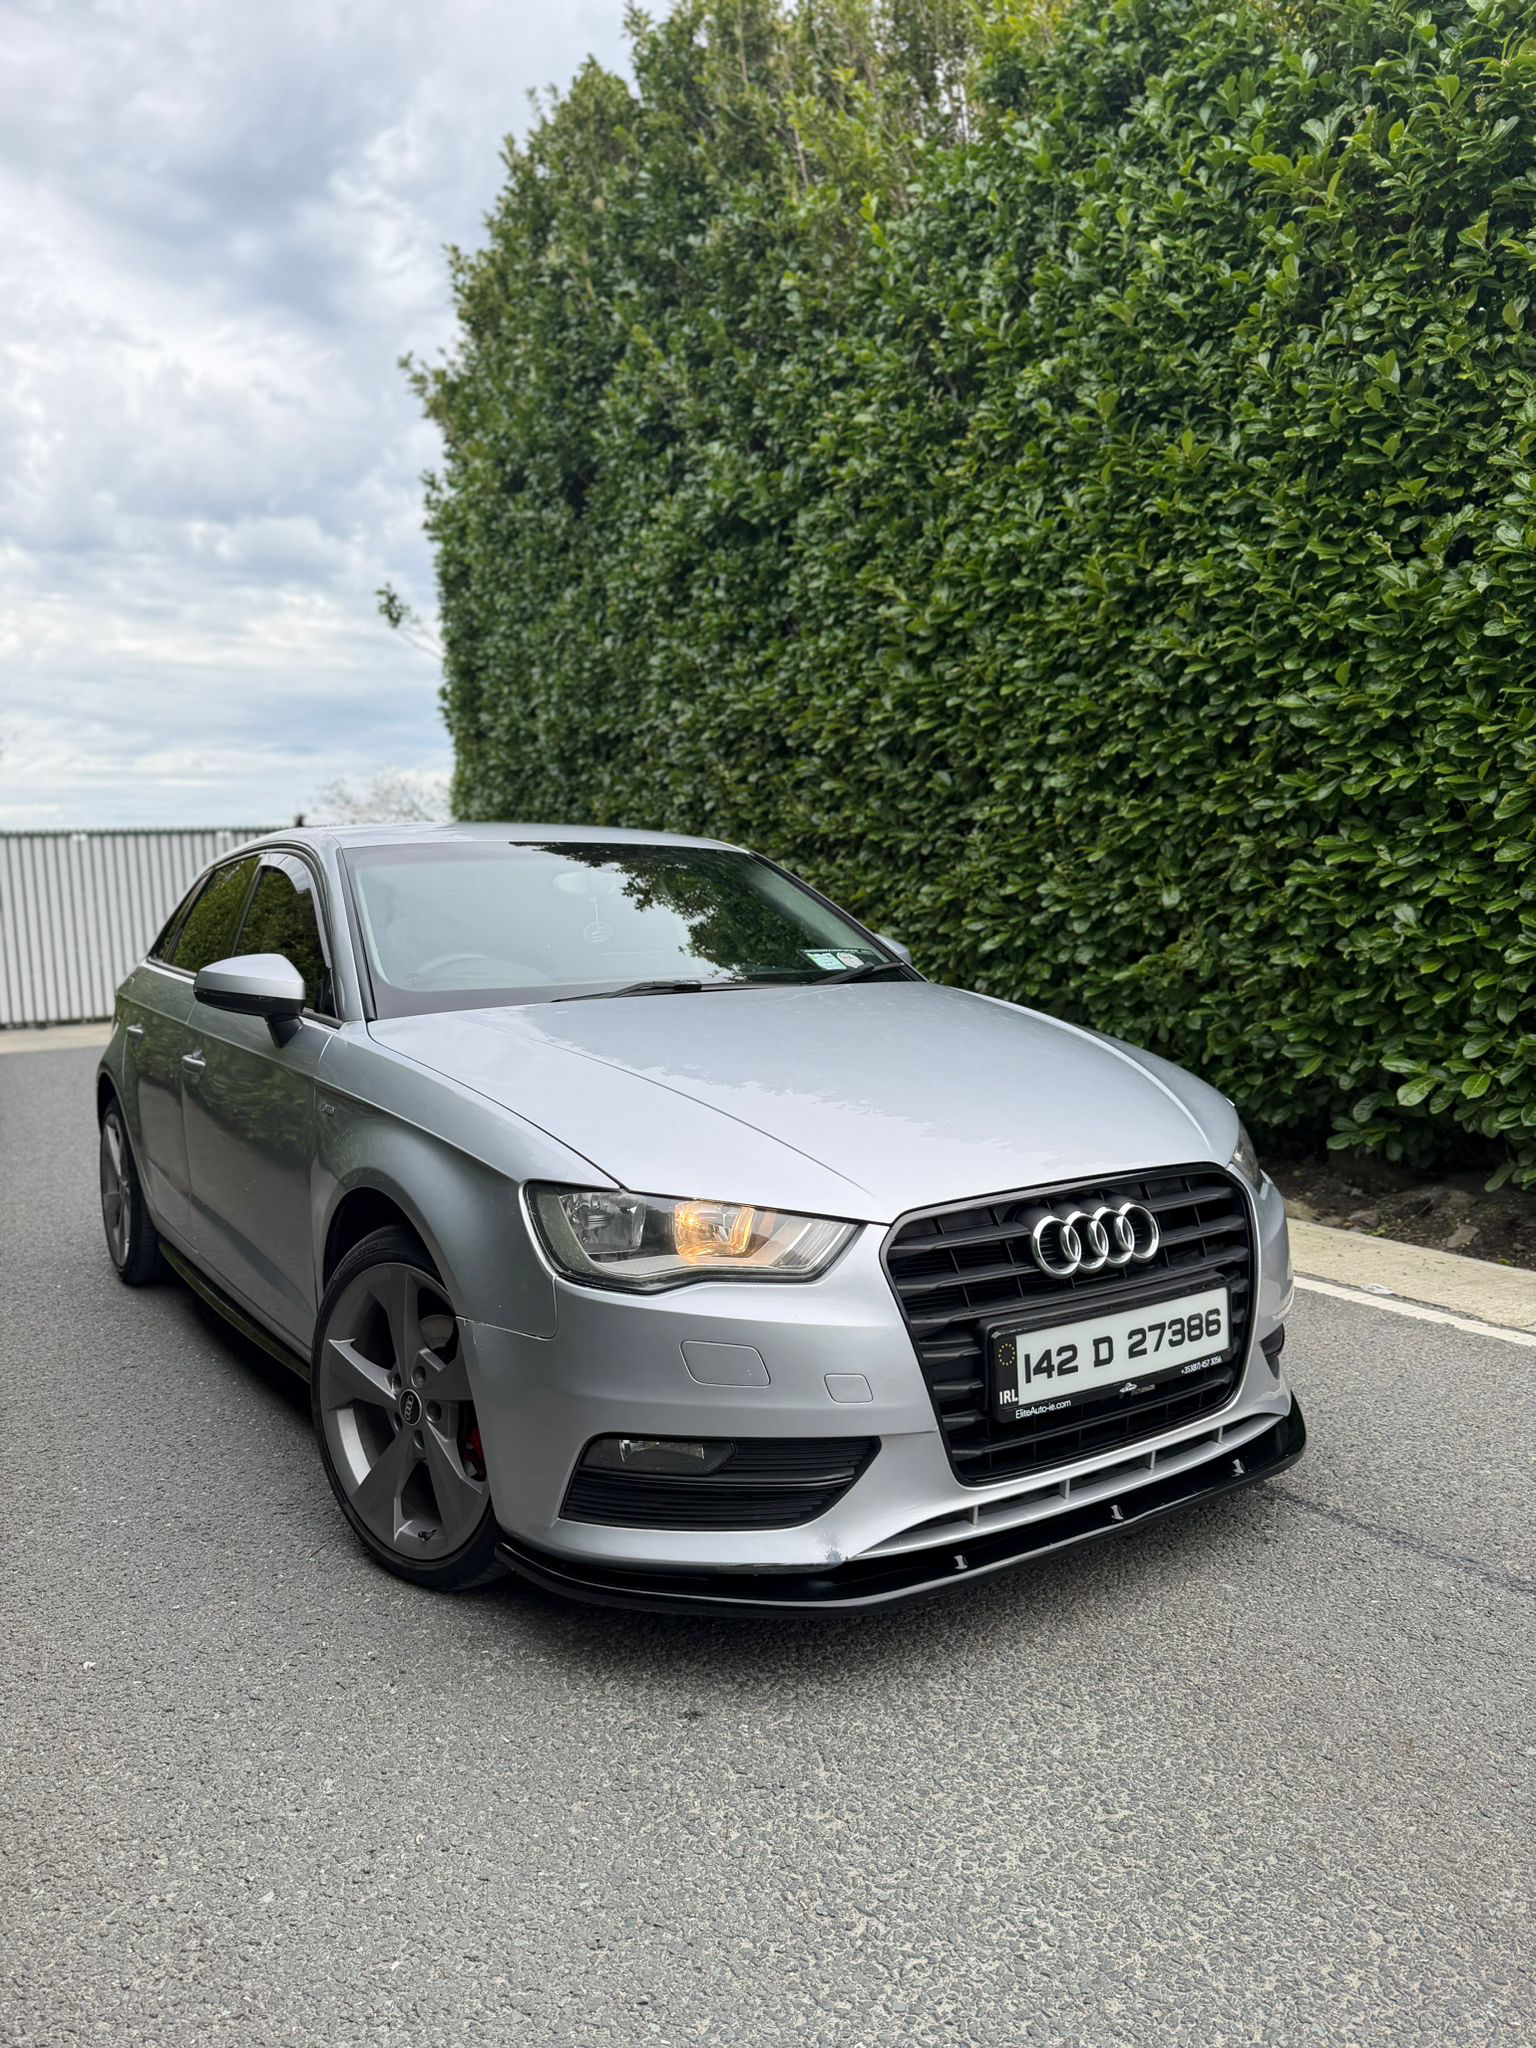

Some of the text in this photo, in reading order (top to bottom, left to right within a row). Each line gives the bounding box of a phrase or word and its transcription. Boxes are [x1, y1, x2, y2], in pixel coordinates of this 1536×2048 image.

[1024, 1307, 1222, 1384] 142 D 27386
[999, 1388, 1019, 1405] IRL
[1015, 1399, 1072, 1419] EliteAuto-ie.com
